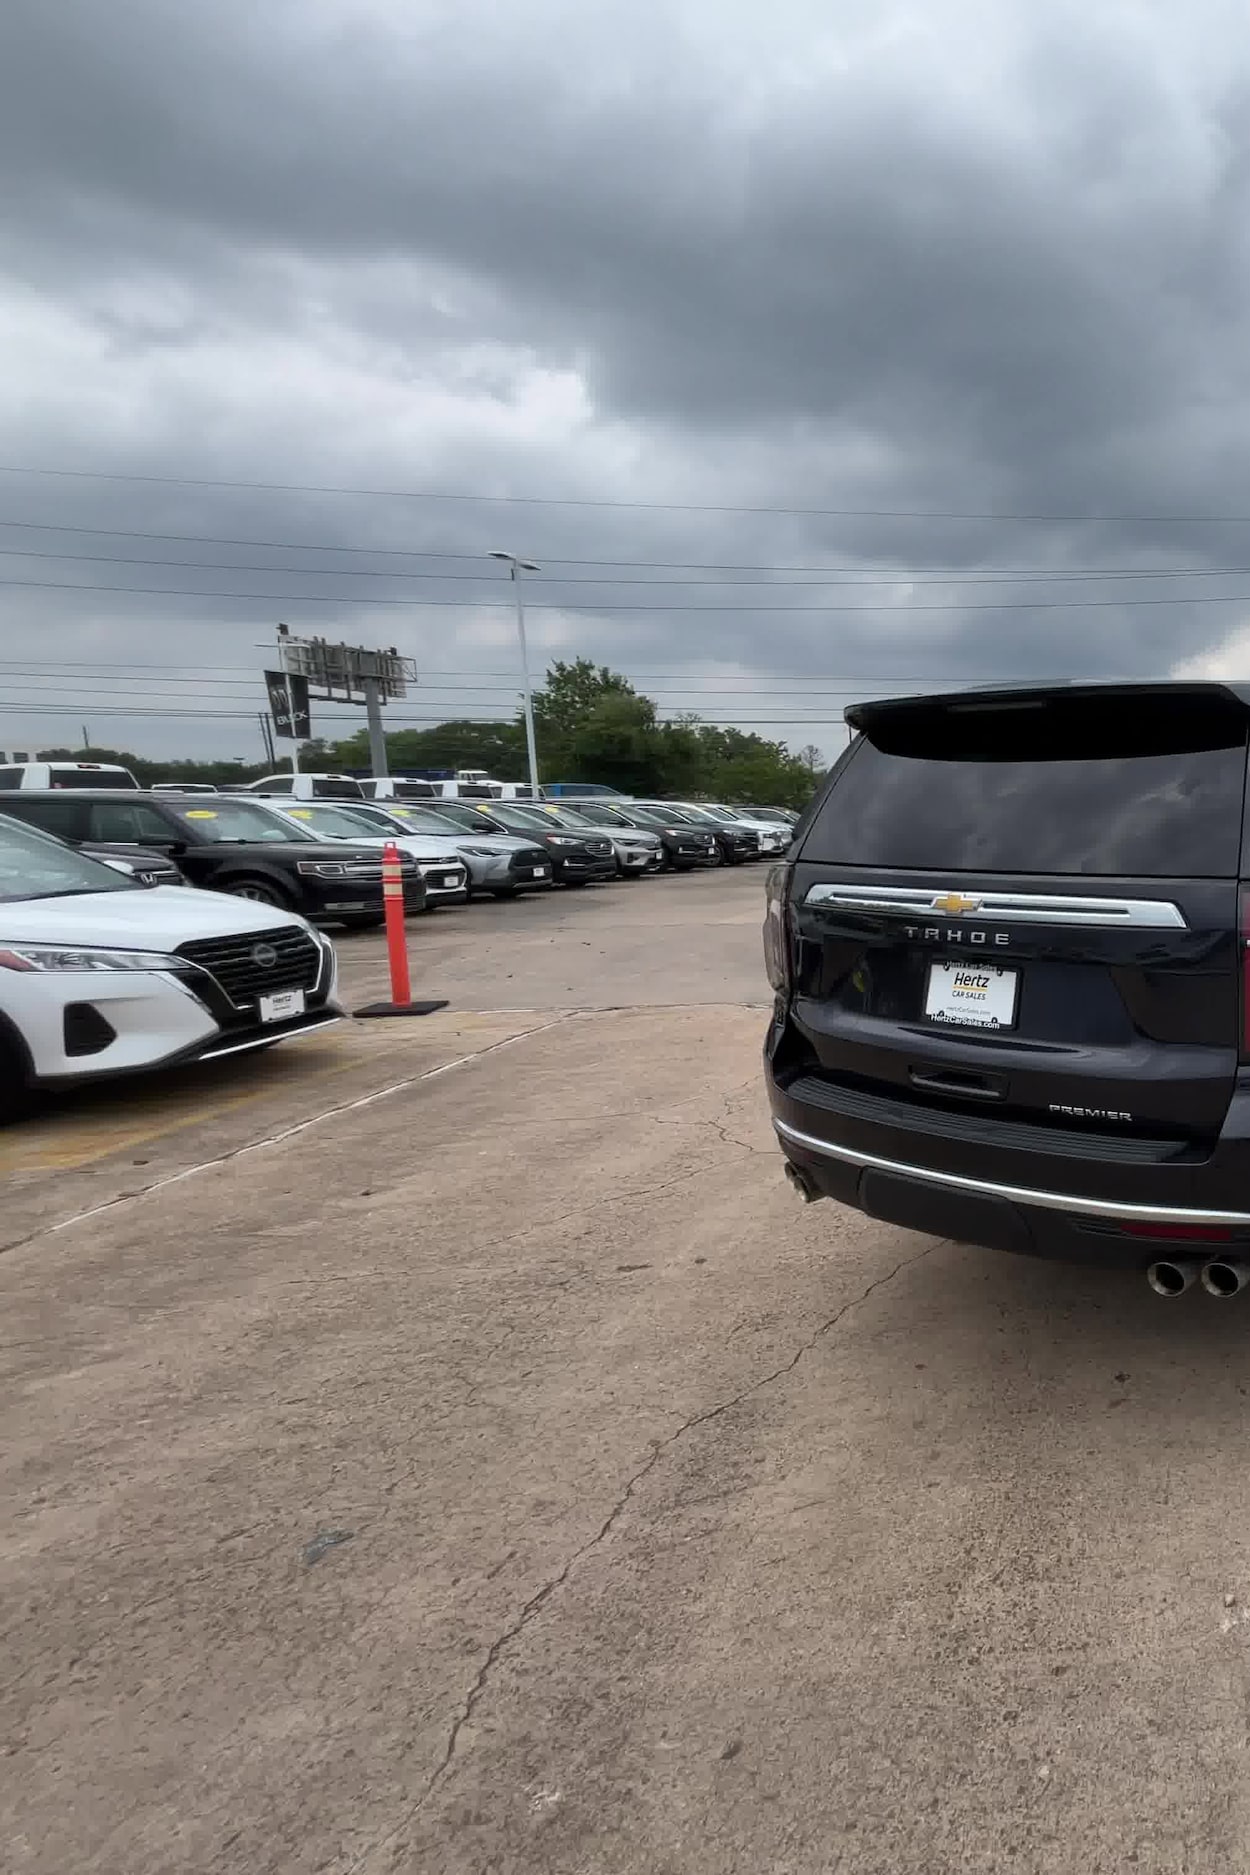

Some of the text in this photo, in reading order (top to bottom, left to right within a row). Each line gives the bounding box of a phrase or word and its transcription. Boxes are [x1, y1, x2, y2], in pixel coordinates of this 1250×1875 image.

[904, 926, 1010, 945] TAHOE
[954, 972, 990, 988] Hertz
[952, 990, 987, 1001] CAR SALES
[930, 1013, 1000, 1029] HertzCarSales.com
[1049, 1104, 1132, 1121] PREMIER
